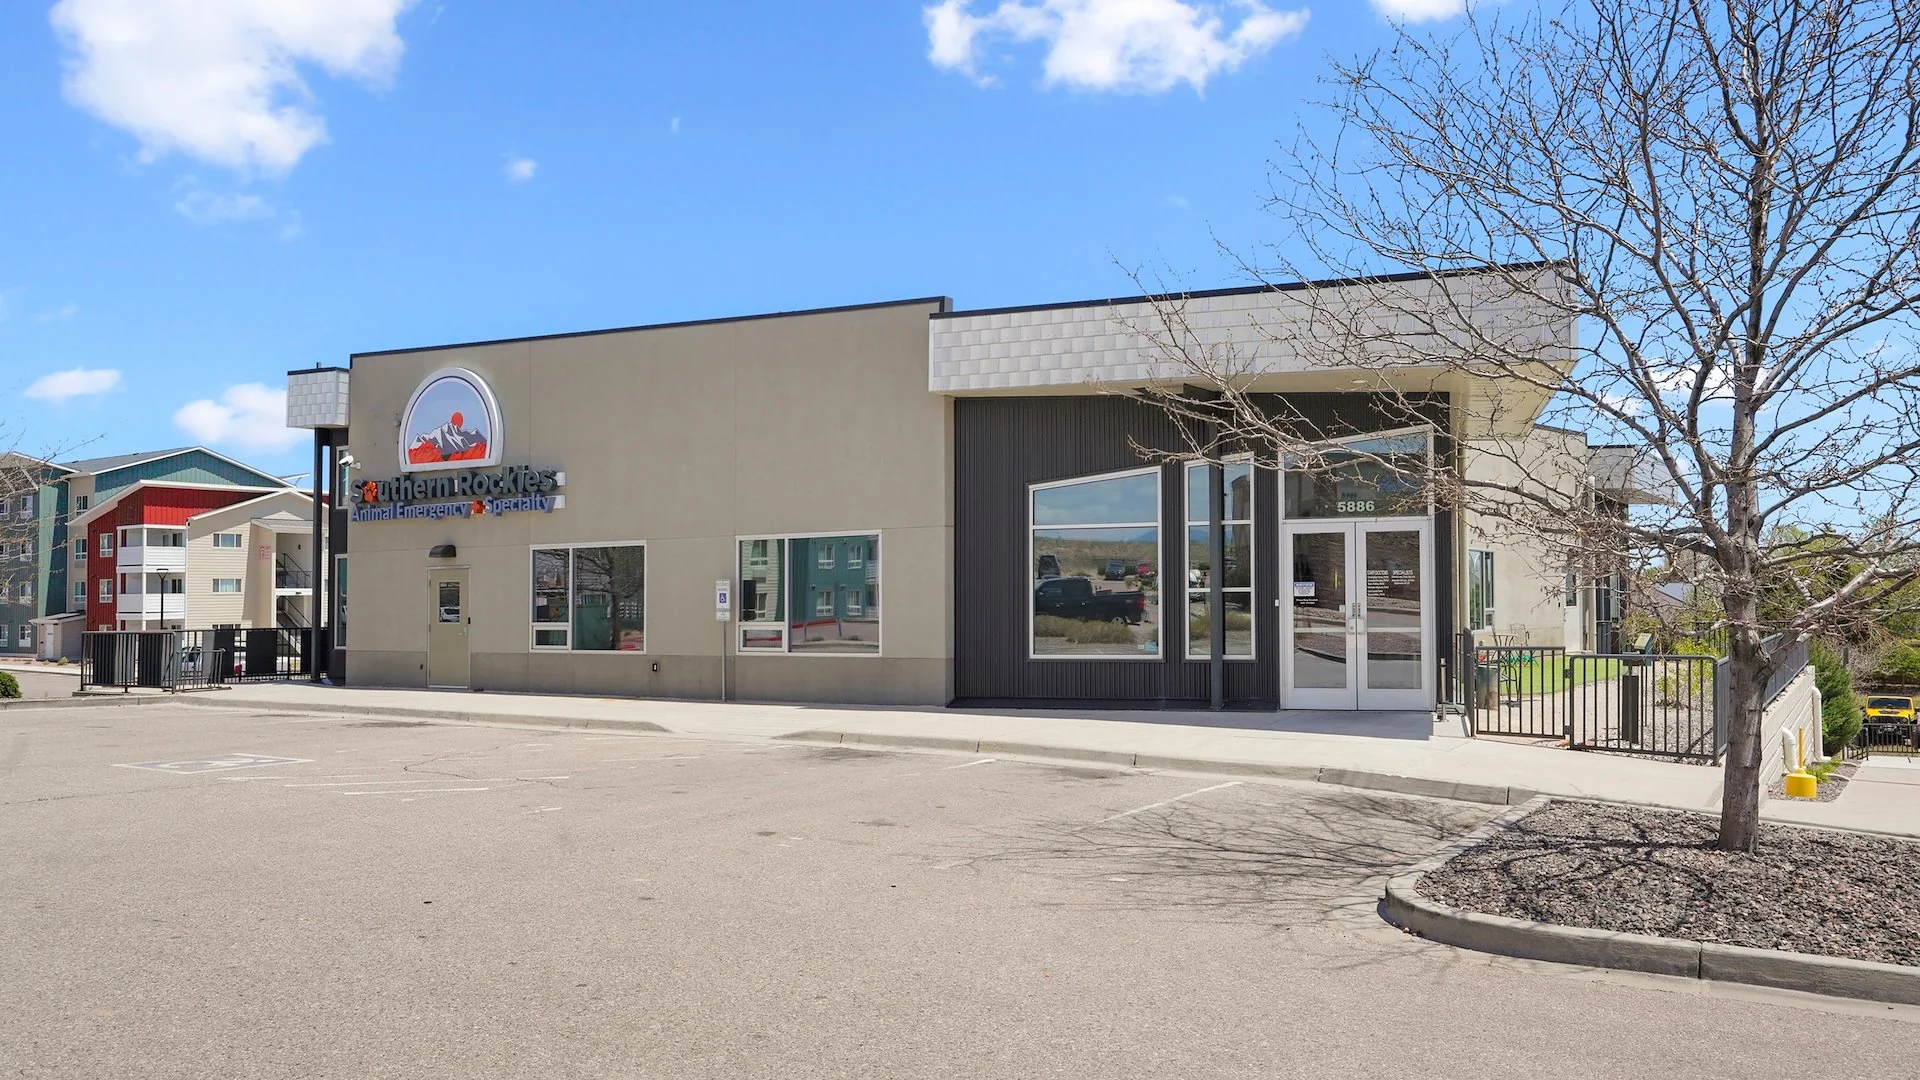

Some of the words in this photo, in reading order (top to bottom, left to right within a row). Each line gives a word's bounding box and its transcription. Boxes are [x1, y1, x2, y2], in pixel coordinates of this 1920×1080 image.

[350, 473, 453, 504] Southern
[457, 466, 557, 496] Rockies
[350, 504, 394, 522] Animal
[397, 502, 469, 519] Emergency
[485, 493, 551, 515] Specialty
[1336, 500, 1376, 513] 5886
